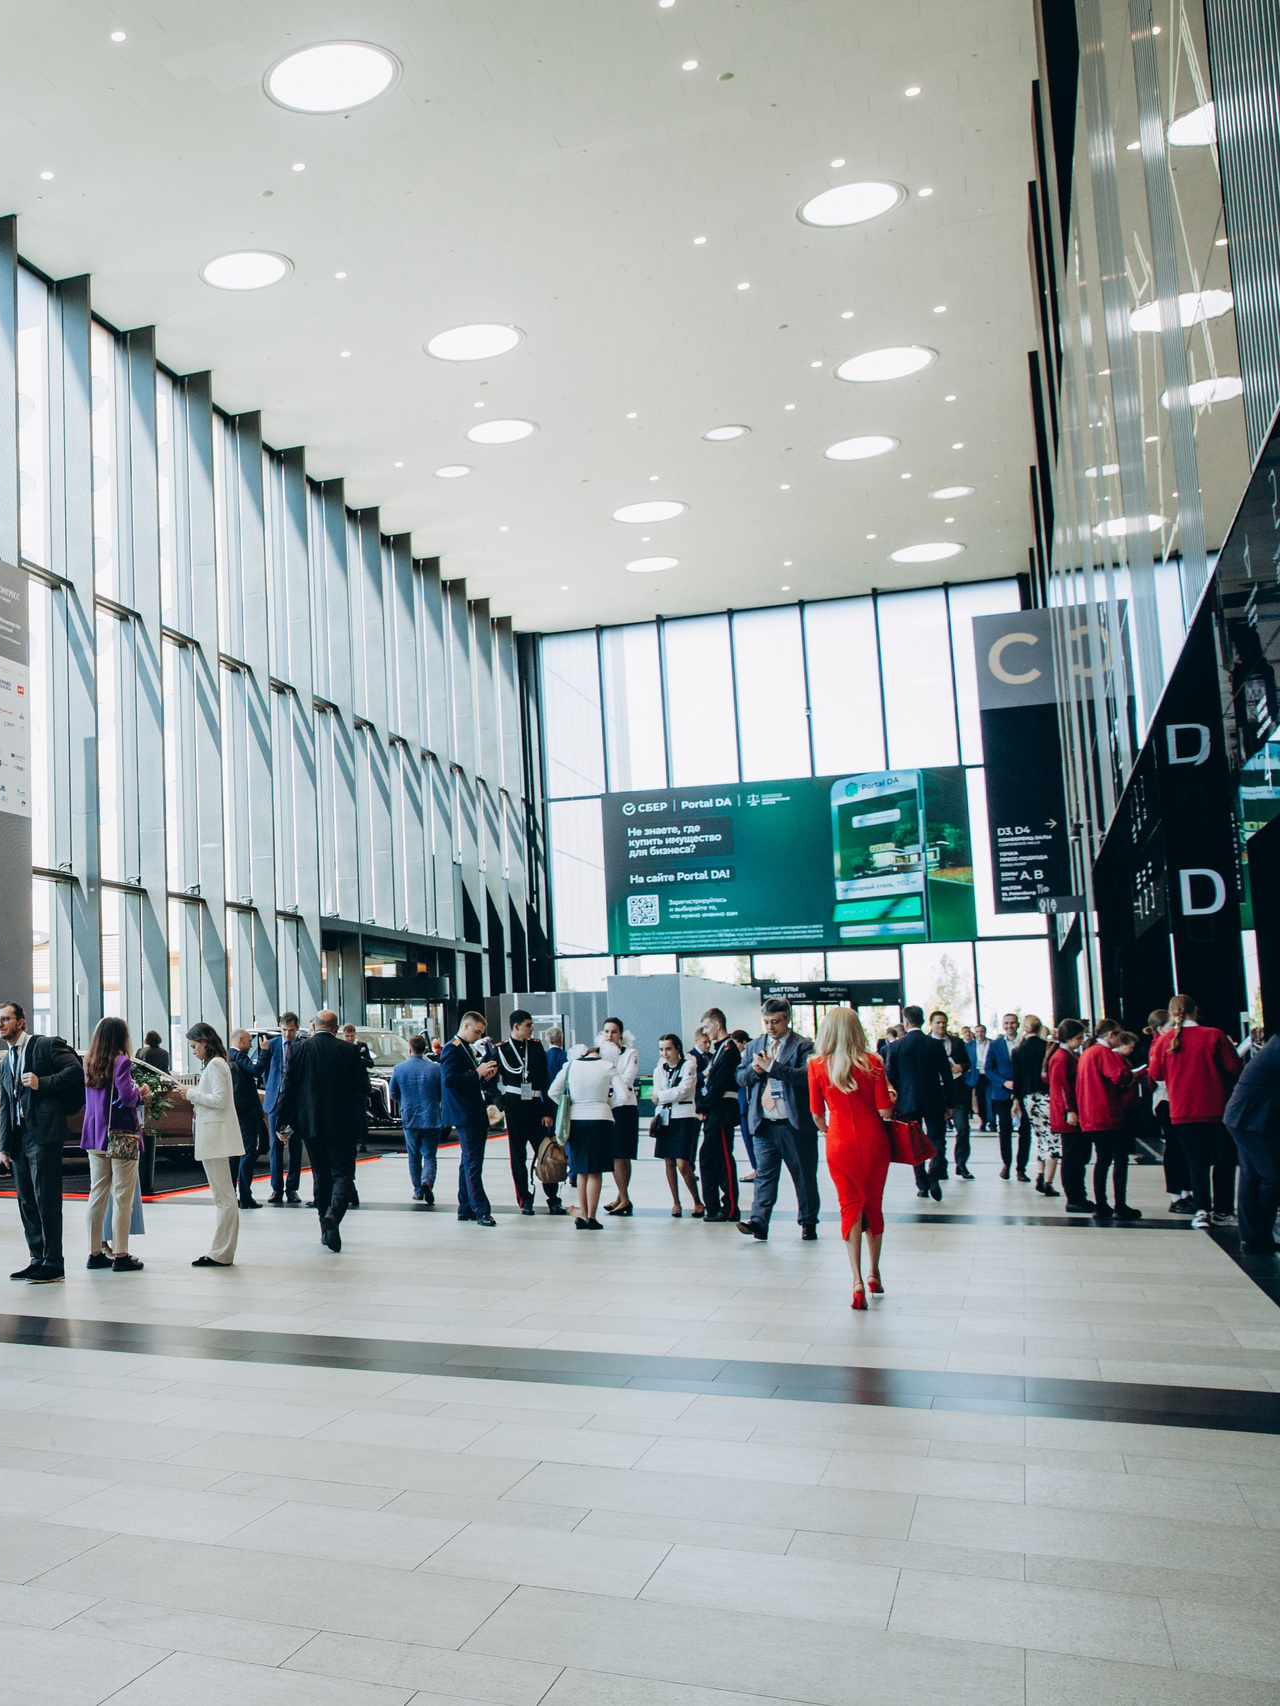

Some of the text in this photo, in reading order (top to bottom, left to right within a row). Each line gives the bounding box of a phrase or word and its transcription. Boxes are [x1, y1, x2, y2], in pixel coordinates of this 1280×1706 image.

[861, 776, 899, 790] Portal DA
[638, 797, 732, 813] СБЕР Portal DA
[627, 824, 701, 837] Не знаете, где
[997, 826, 1031, 836] D3, D4
[628, 833, 722, 848] купить имущество
[628, 844, 696, 859] для бизнеса?
[629, 869, 730, 884] На сайте Portal DA!
[1034, 870, 1044, 880] B
[1178, 868, 1226, 916] D
